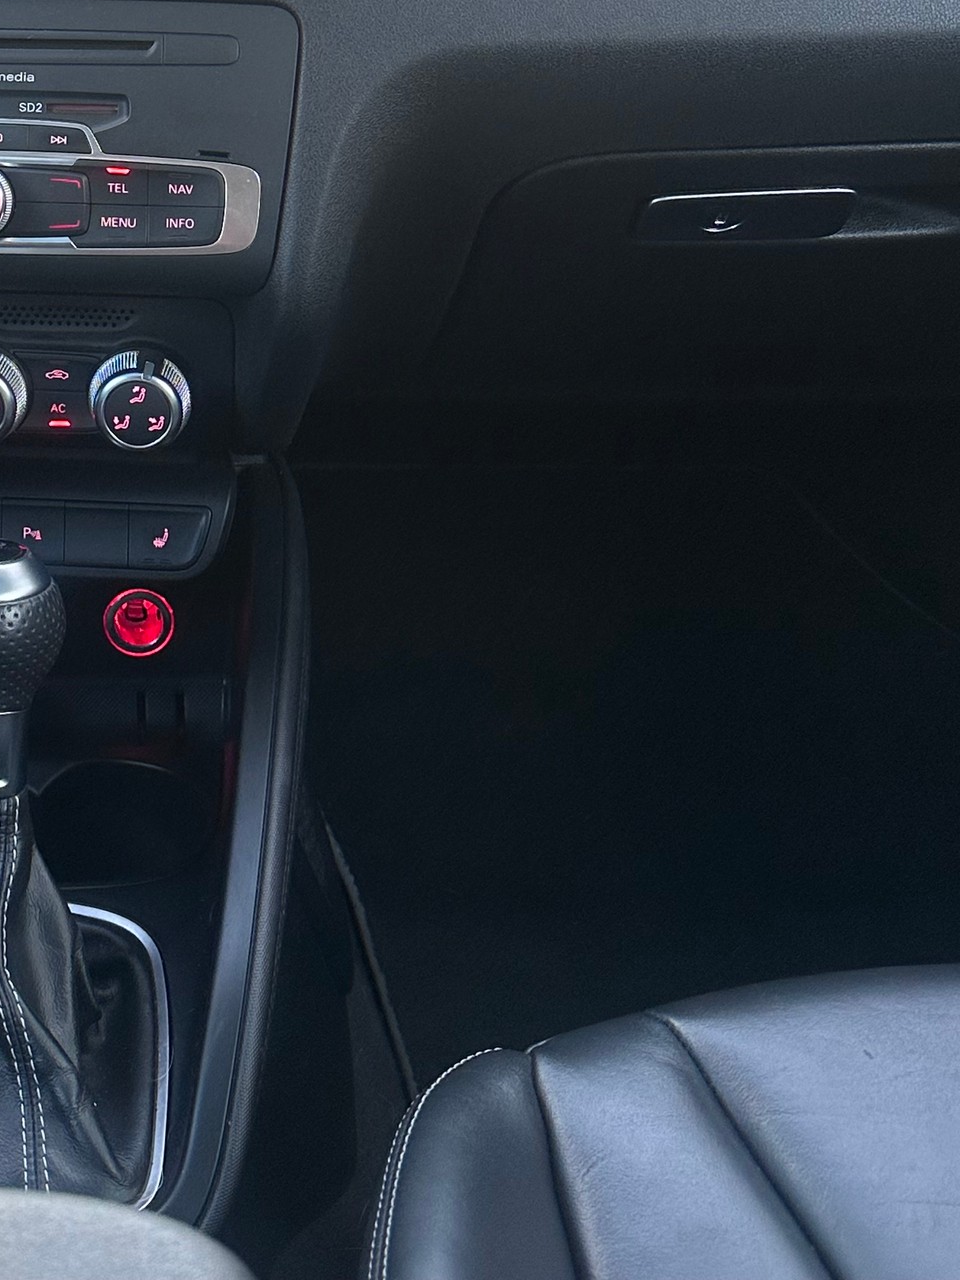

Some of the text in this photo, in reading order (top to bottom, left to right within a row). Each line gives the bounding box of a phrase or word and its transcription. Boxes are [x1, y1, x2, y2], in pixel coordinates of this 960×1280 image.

[19, 102, 43, 113] SD2
[108, 183, 128, 193] TEL
[168, 184, 193, 194] NAV
[100, 217, 137, 228] MENU
[166, 218, 195, 229] INFO
[50, 404, 66, 413] AC
